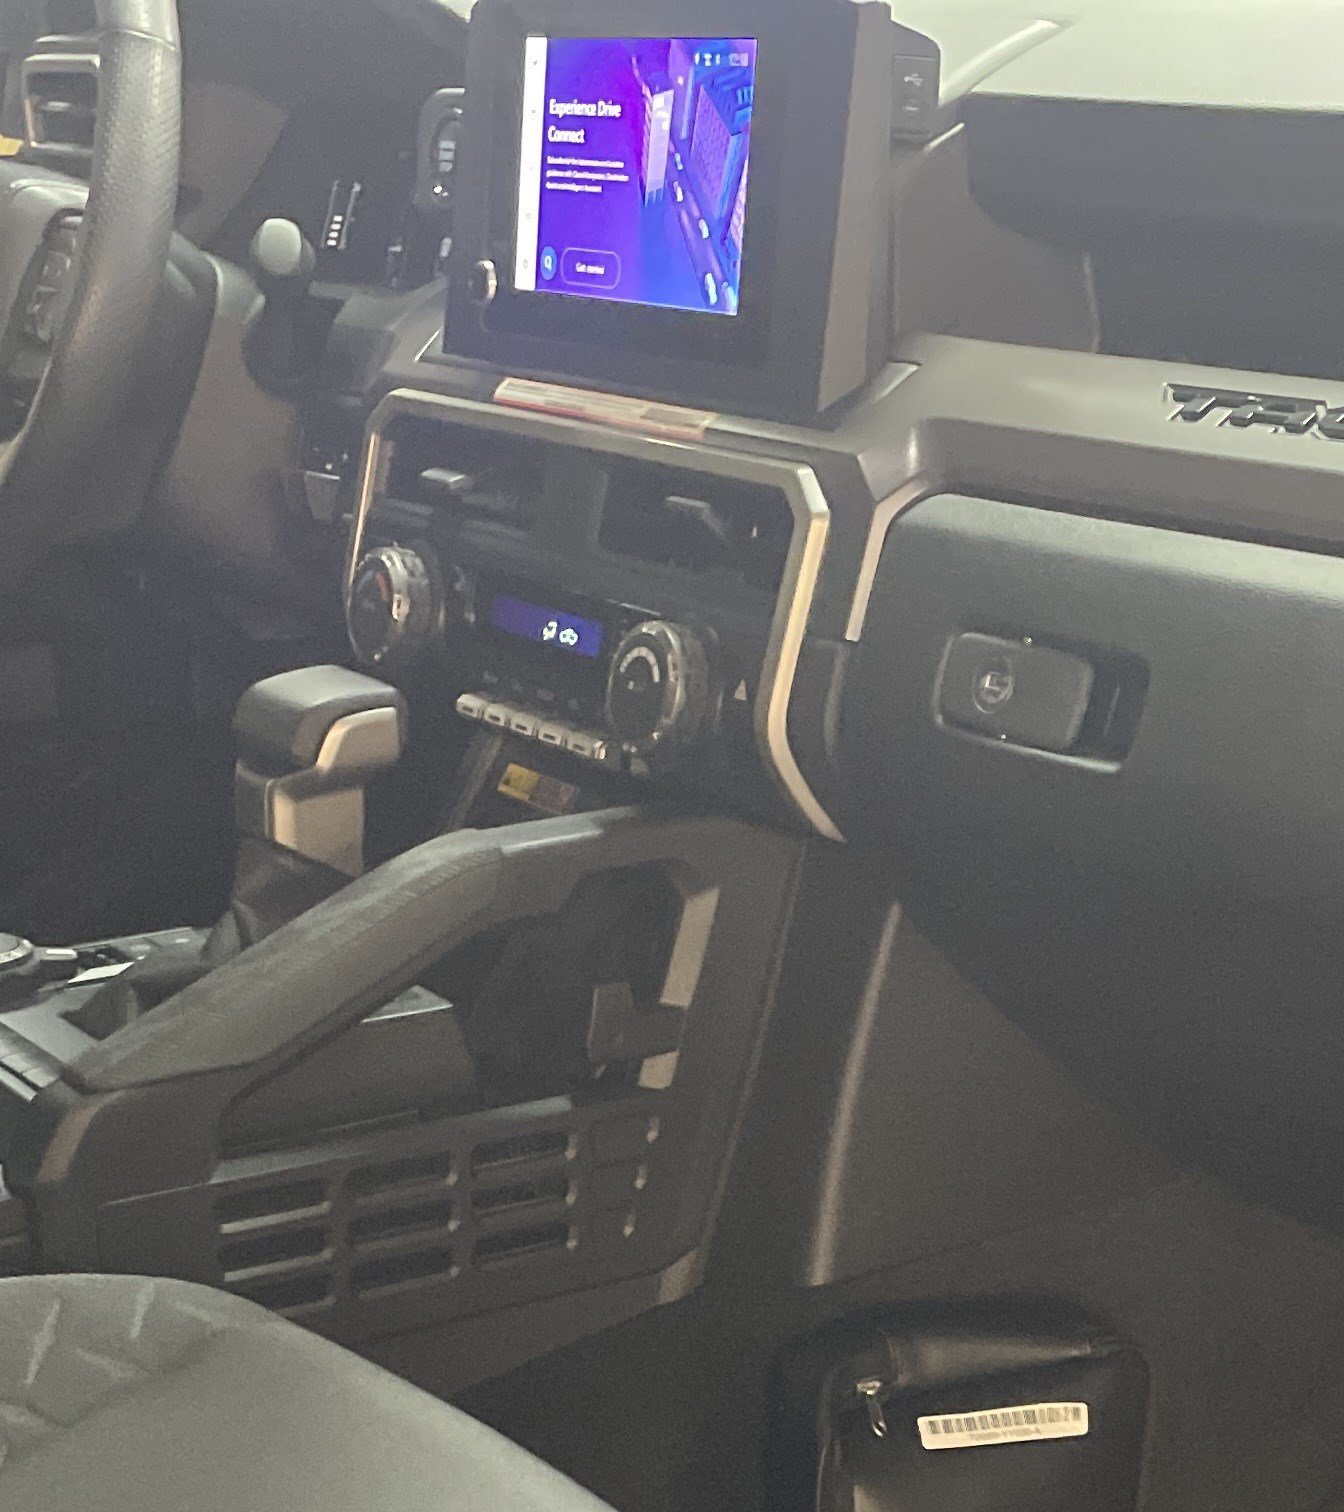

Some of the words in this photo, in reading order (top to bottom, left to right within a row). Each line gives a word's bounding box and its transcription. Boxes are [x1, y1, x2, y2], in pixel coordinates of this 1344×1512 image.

[549, 98, 596, 118] Experience
[597, 99, 622, 117] Drive
[547, 125, 585, 144] Connect
